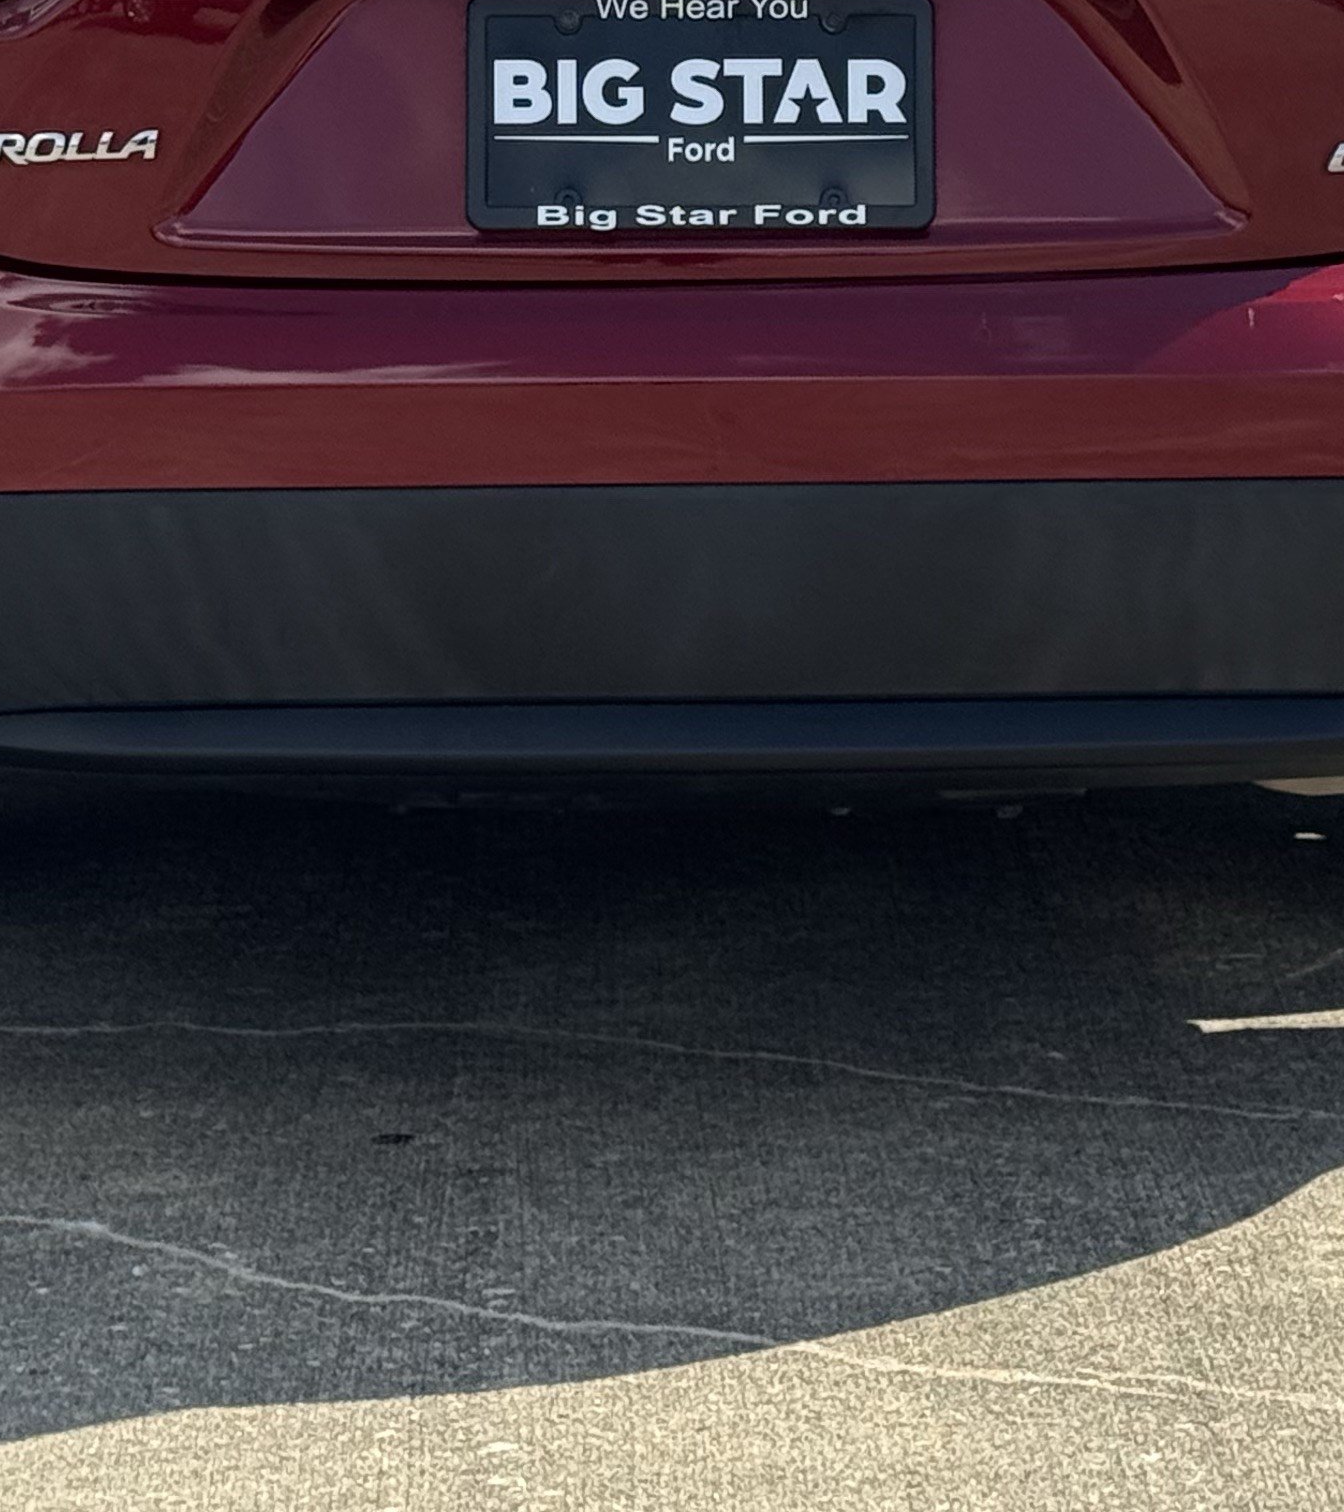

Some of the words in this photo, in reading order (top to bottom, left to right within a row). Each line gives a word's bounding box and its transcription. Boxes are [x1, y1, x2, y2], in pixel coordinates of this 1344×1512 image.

[493, 58, 645, 125] BIG
[669, 58, 907, 125] STAR
[667, 135, 735, 163] Ford
[536, 204, 617, 231] Big
[635, 204, 738, 226] Star
[754, 204, 867, 226] Ford
